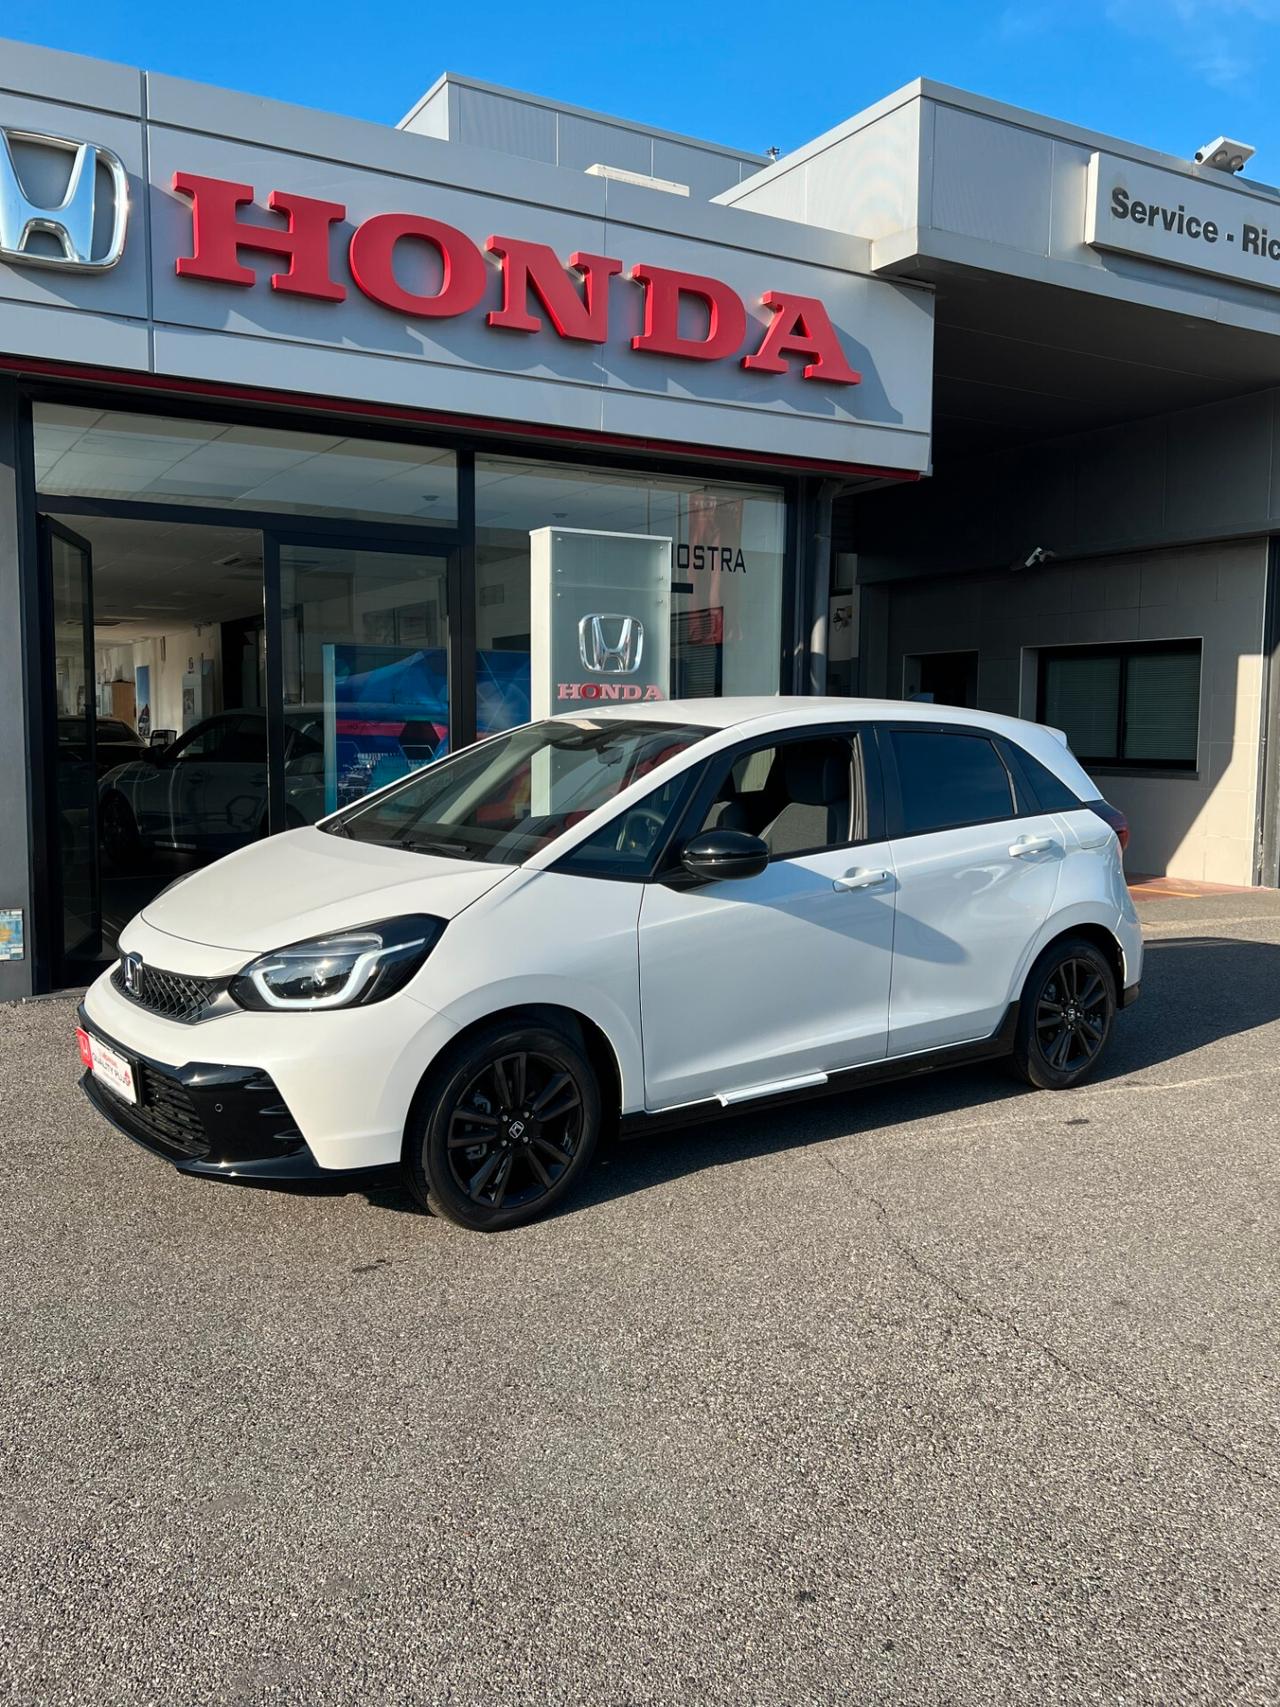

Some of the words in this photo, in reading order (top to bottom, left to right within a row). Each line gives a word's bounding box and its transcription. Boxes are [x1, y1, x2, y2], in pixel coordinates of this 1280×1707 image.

[1111, 187, 1219, 243] Service
[172, 171, 862, 386] HONDA
[671, 543, 747, 574] OSTRA
[557, 683, 665, 701] HONDA
